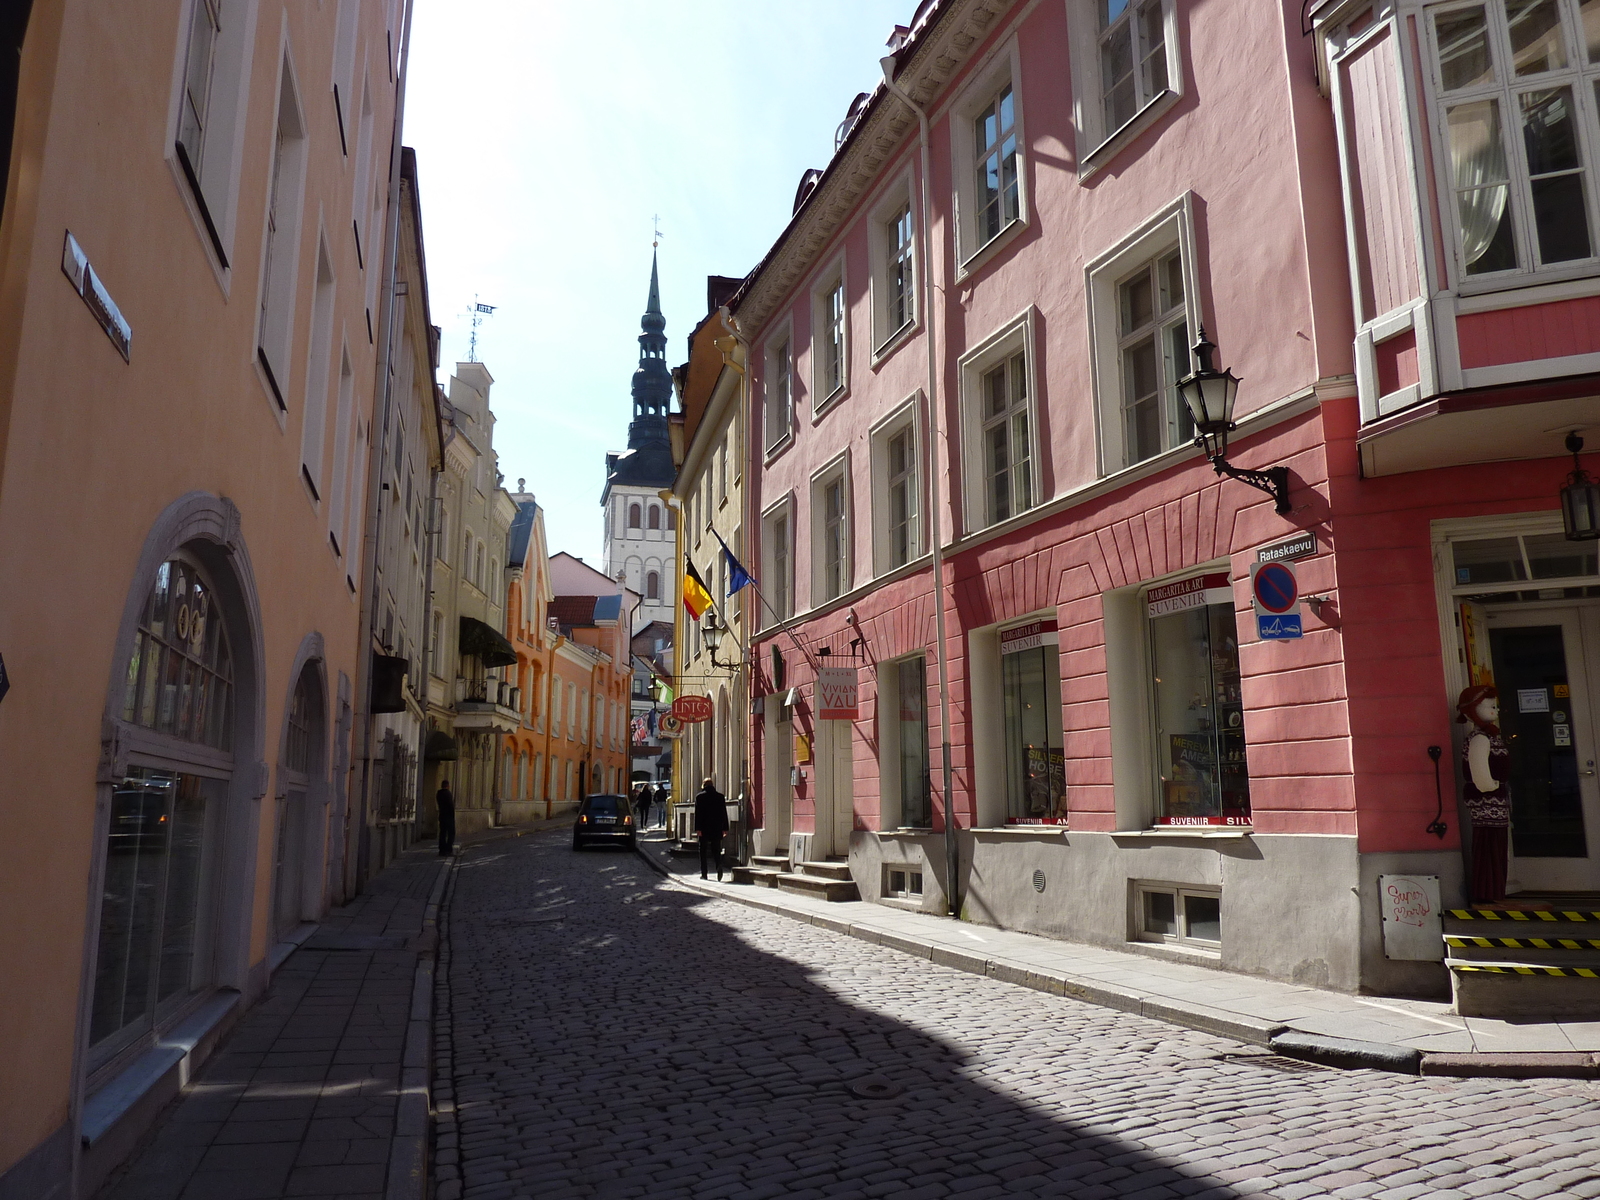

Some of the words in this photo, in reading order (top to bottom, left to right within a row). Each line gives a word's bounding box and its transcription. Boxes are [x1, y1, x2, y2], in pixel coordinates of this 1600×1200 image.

[1260, 541, 1311, 562] Rataskaevu
[1149, 583, 1185, 602] MARGARITA
[1185, 581, 1190, 592] &
[1191, 577, 1205, 590] ART
[1149, 592, 1206, 616] SUVENIIR
[1032, 623, 1041, 633] ART
[1002, 634, 1042, 653] SUVENIIR
[821, 683, 857, 693] VIVIAN
[675, 702, 710, 713] LINTEX
[822, 693, 857, 708] VAU
[1028, 749, 1064, 765] SILVER
[1170, 817, 1209, 825] SUVENIIR
